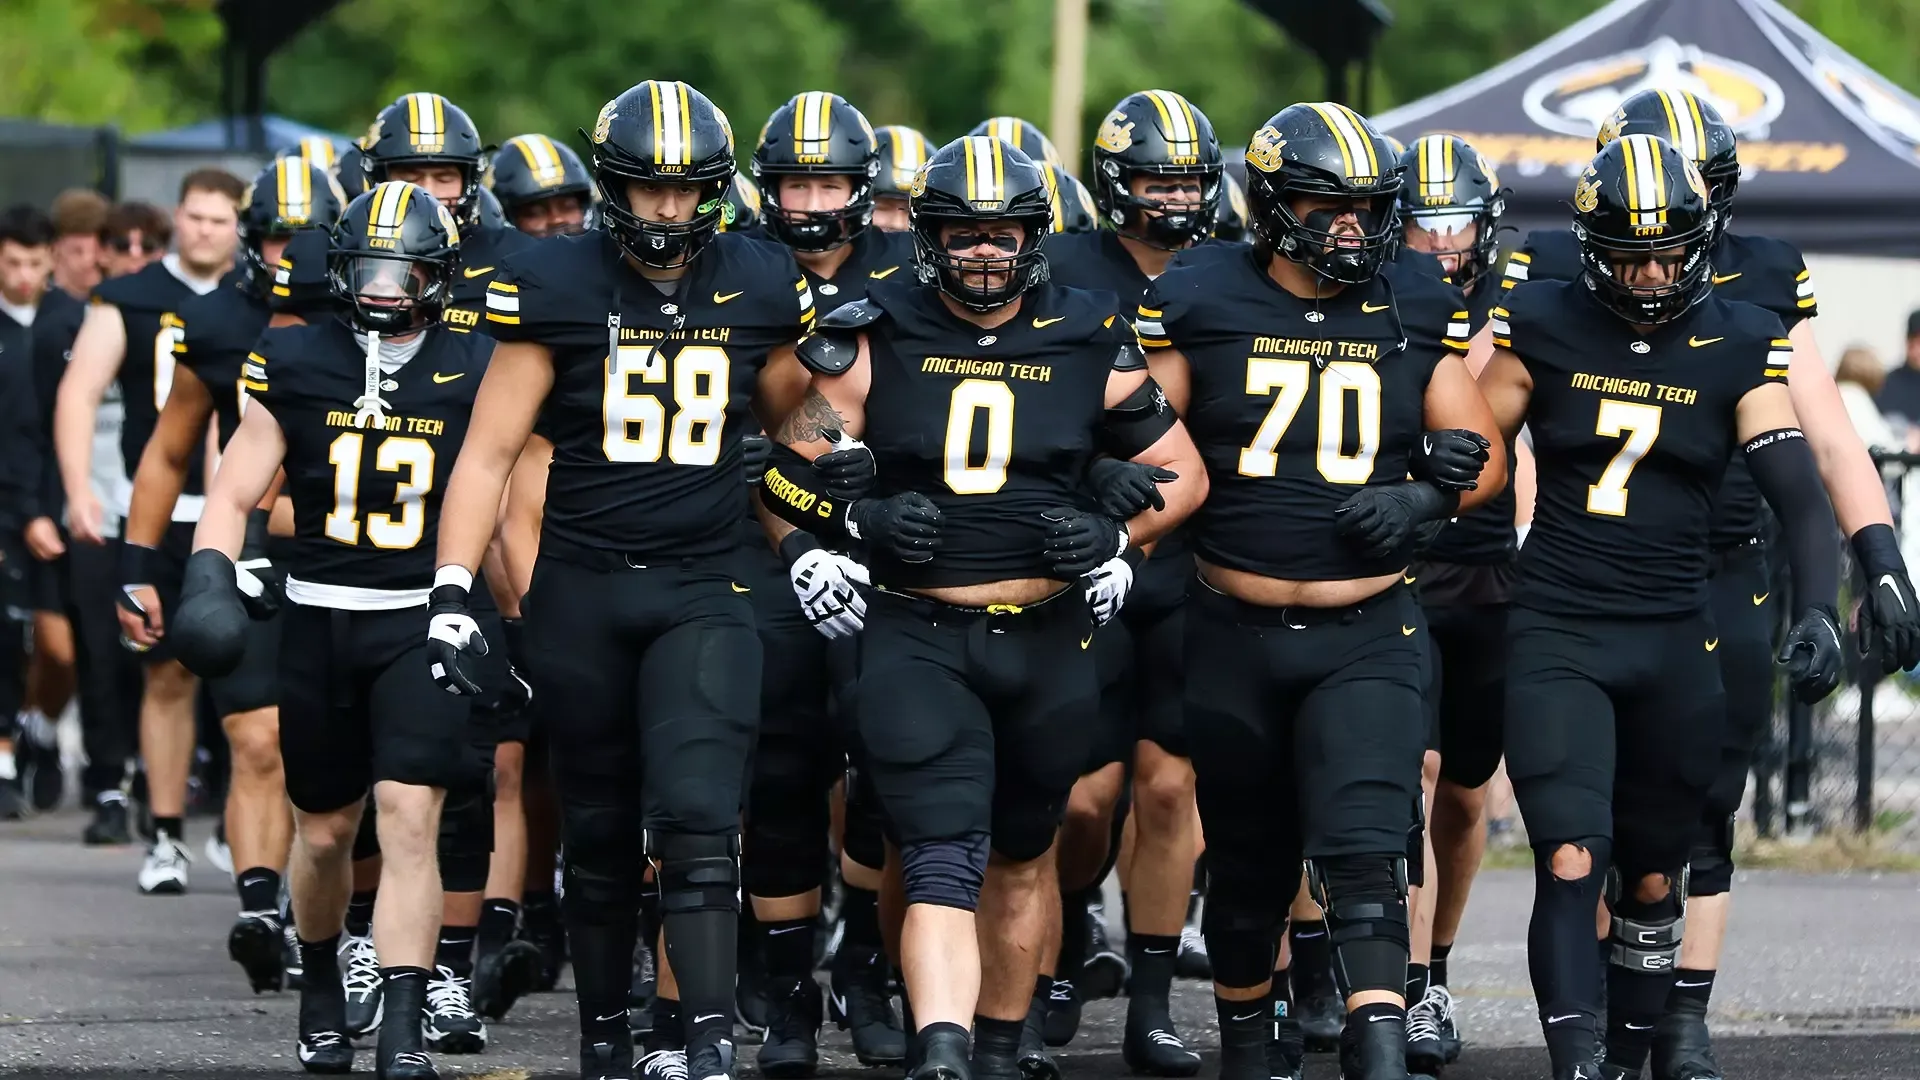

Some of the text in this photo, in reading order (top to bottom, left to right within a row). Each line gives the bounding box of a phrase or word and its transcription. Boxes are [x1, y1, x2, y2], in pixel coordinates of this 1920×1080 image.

[619, 327, 731, 343] ICHIGAN TECH
[921, 356, 1052, 382] MICHIGAN TECH
[1252, 337, 1379, 360] MICHIGAN TECH
[325, 411, 444, 436] MICIAN TECH
[602, 345, 731, 467] 68
[1238, 357, 1382, 485] 70
[1571, 372, 1698, 405] MICHIGAN TECH
[944, 378, 1015, 495] 0
[1586, 398, 1663, 517] 7
[325, 431, 436, 549] 13
